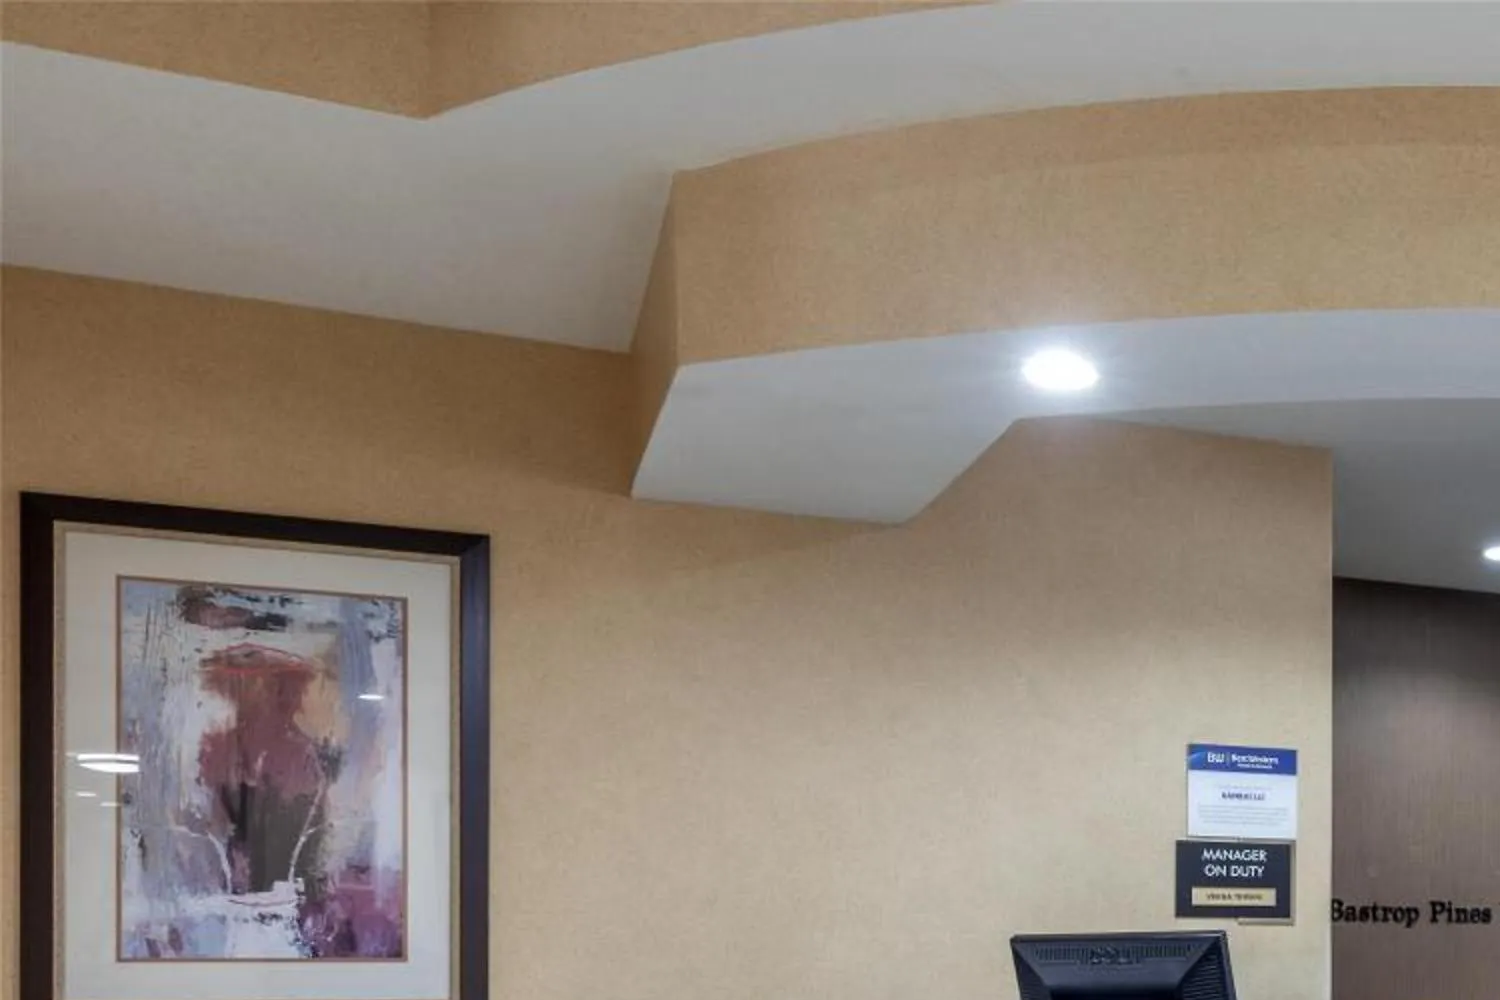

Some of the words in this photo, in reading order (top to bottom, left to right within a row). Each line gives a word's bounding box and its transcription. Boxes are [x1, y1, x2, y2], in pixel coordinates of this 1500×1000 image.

[1202, 848, 1268, 862] MANAGER
[1204, 864, 1227, 877] ON
[1231, 865, 1264, 877] DUTY
[1331, 899, 1419, 928] Bastrop
[1430, 900, 1492, 925] Pines
